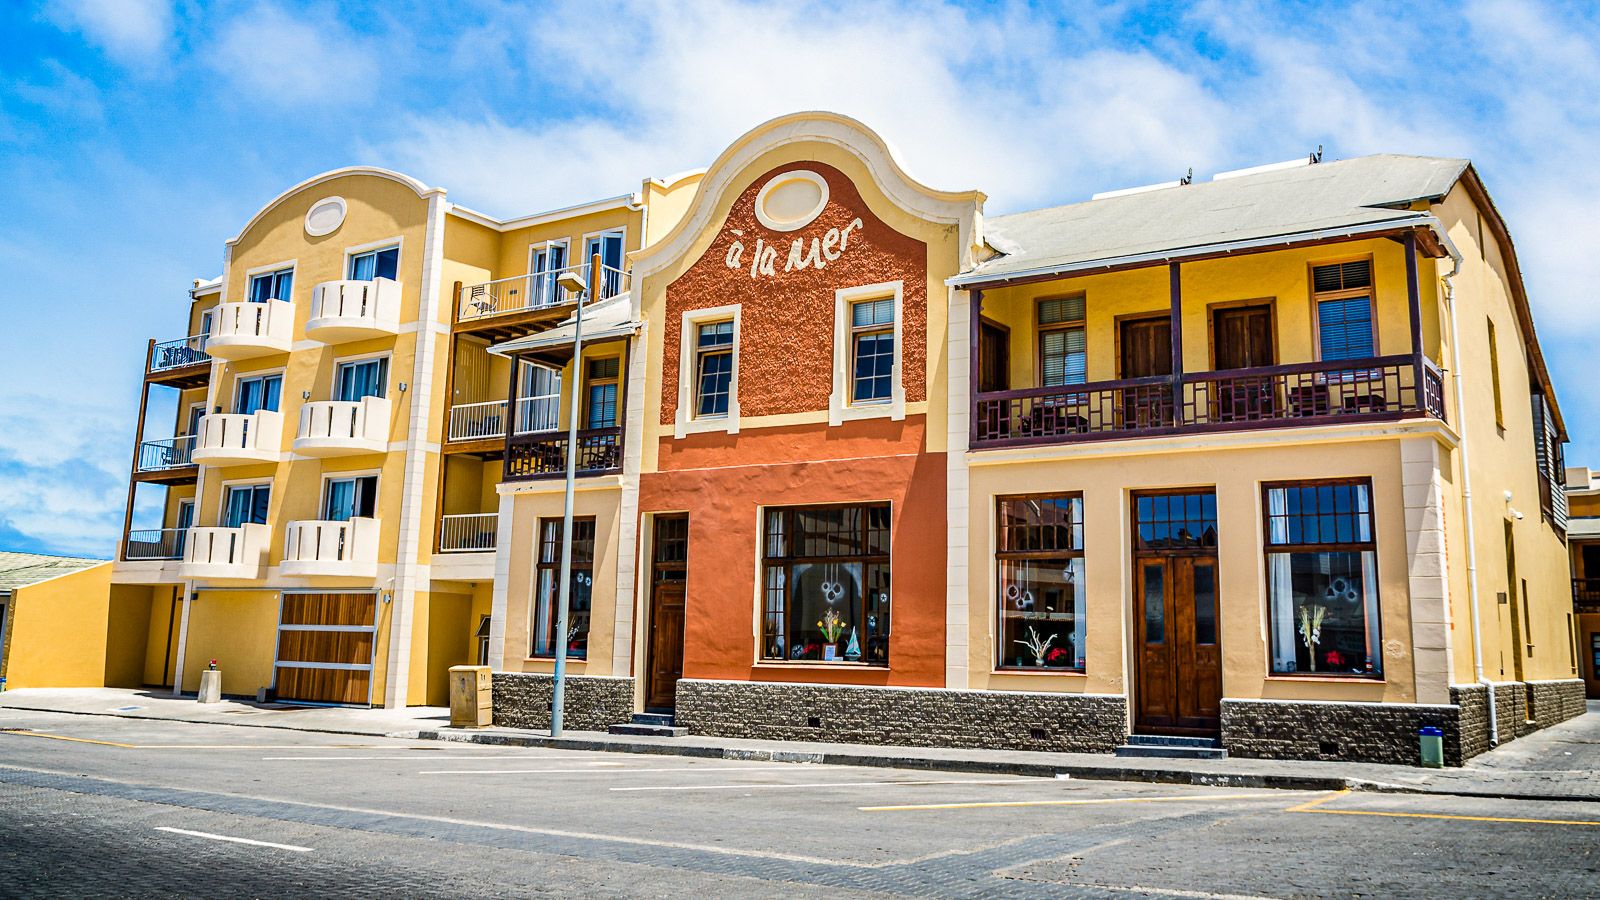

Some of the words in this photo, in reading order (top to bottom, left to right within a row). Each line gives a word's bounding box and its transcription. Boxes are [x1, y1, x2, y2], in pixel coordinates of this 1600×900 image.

[726, 229, 744, 269] à
[751, 239, 778, 278] la
[784, 217, 863, 272] Mer
